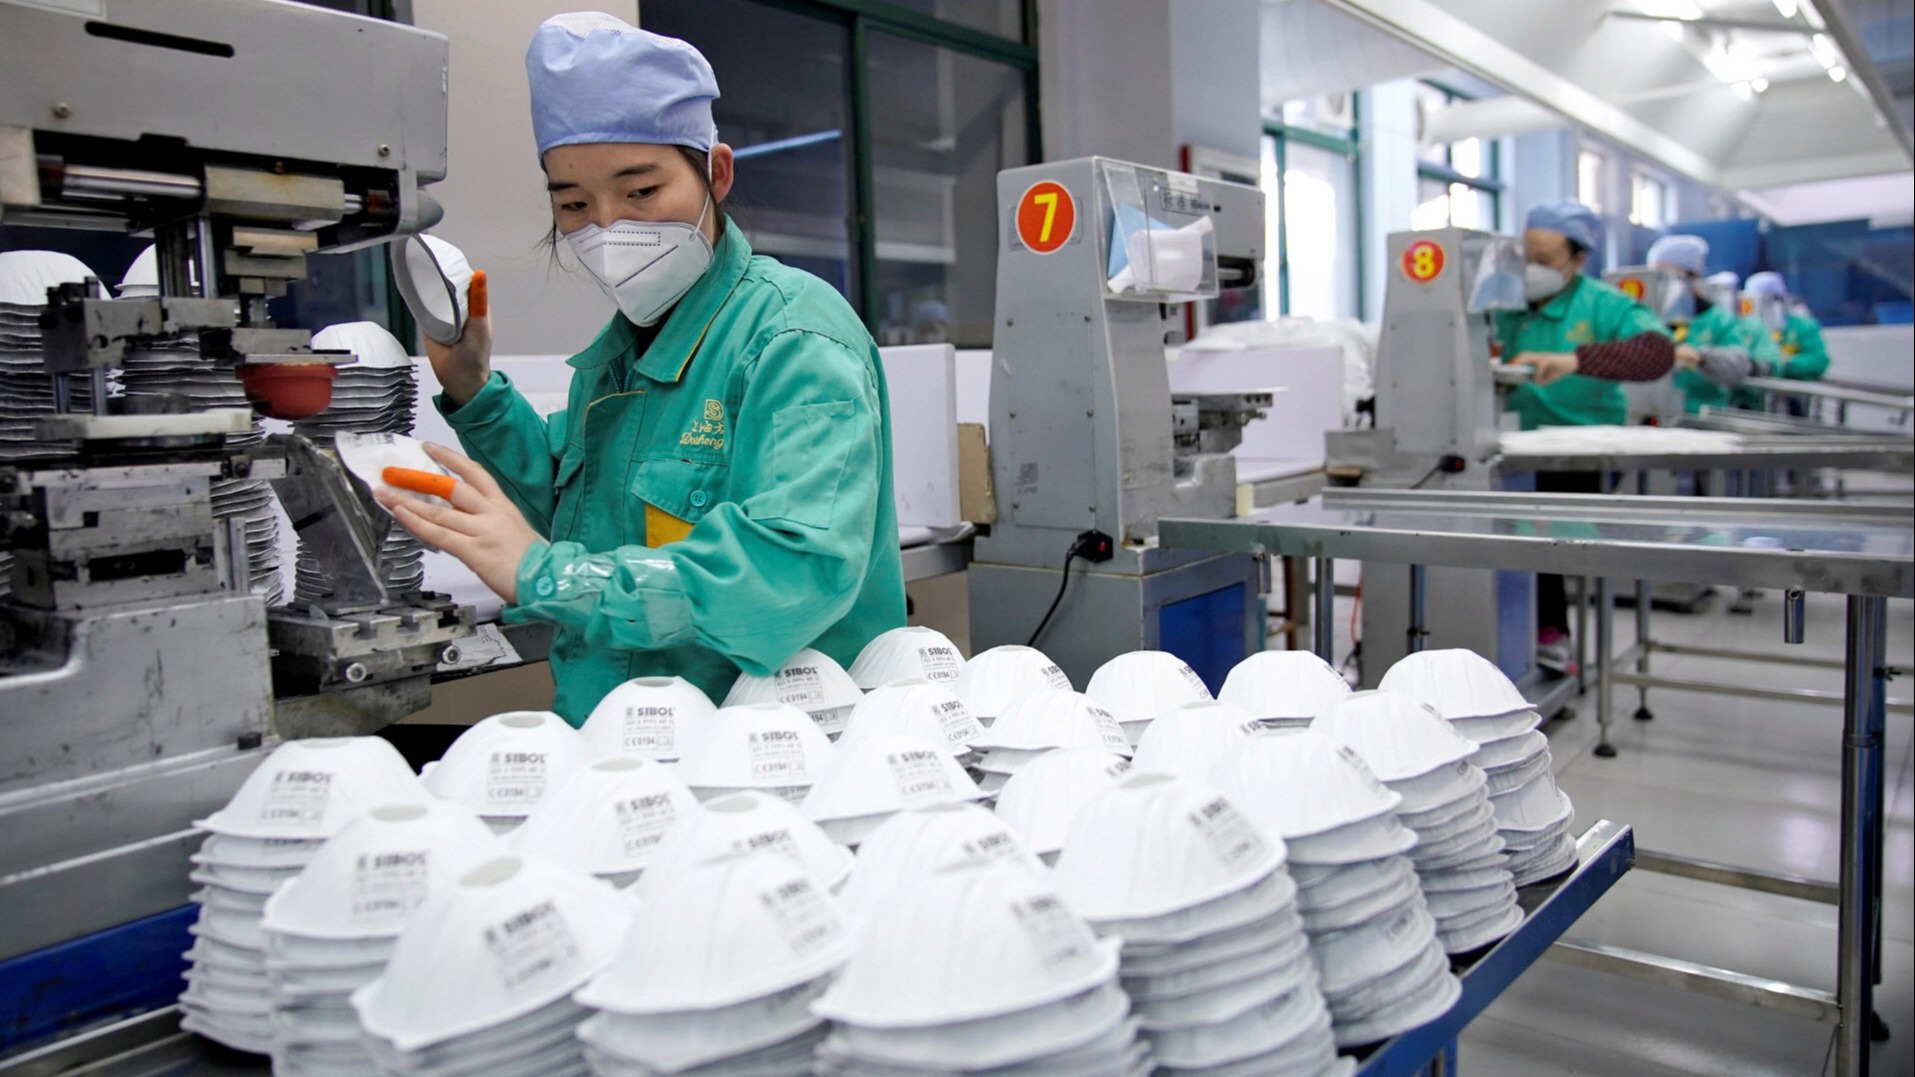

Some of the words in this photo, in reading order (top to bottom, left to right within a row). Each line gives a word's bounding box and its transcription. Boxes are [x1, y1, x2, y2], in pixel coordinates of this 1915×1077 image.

[1034, 192, 1058, 243] 7
[1413, 245, 1435, 277] 8
[784, 666, 818, 678] SIBOL
[637, 706, 674, 717] SIBOL
[761, 730, 799, 741] SIBOL
[504, 751, 546, 764] SIBOL
